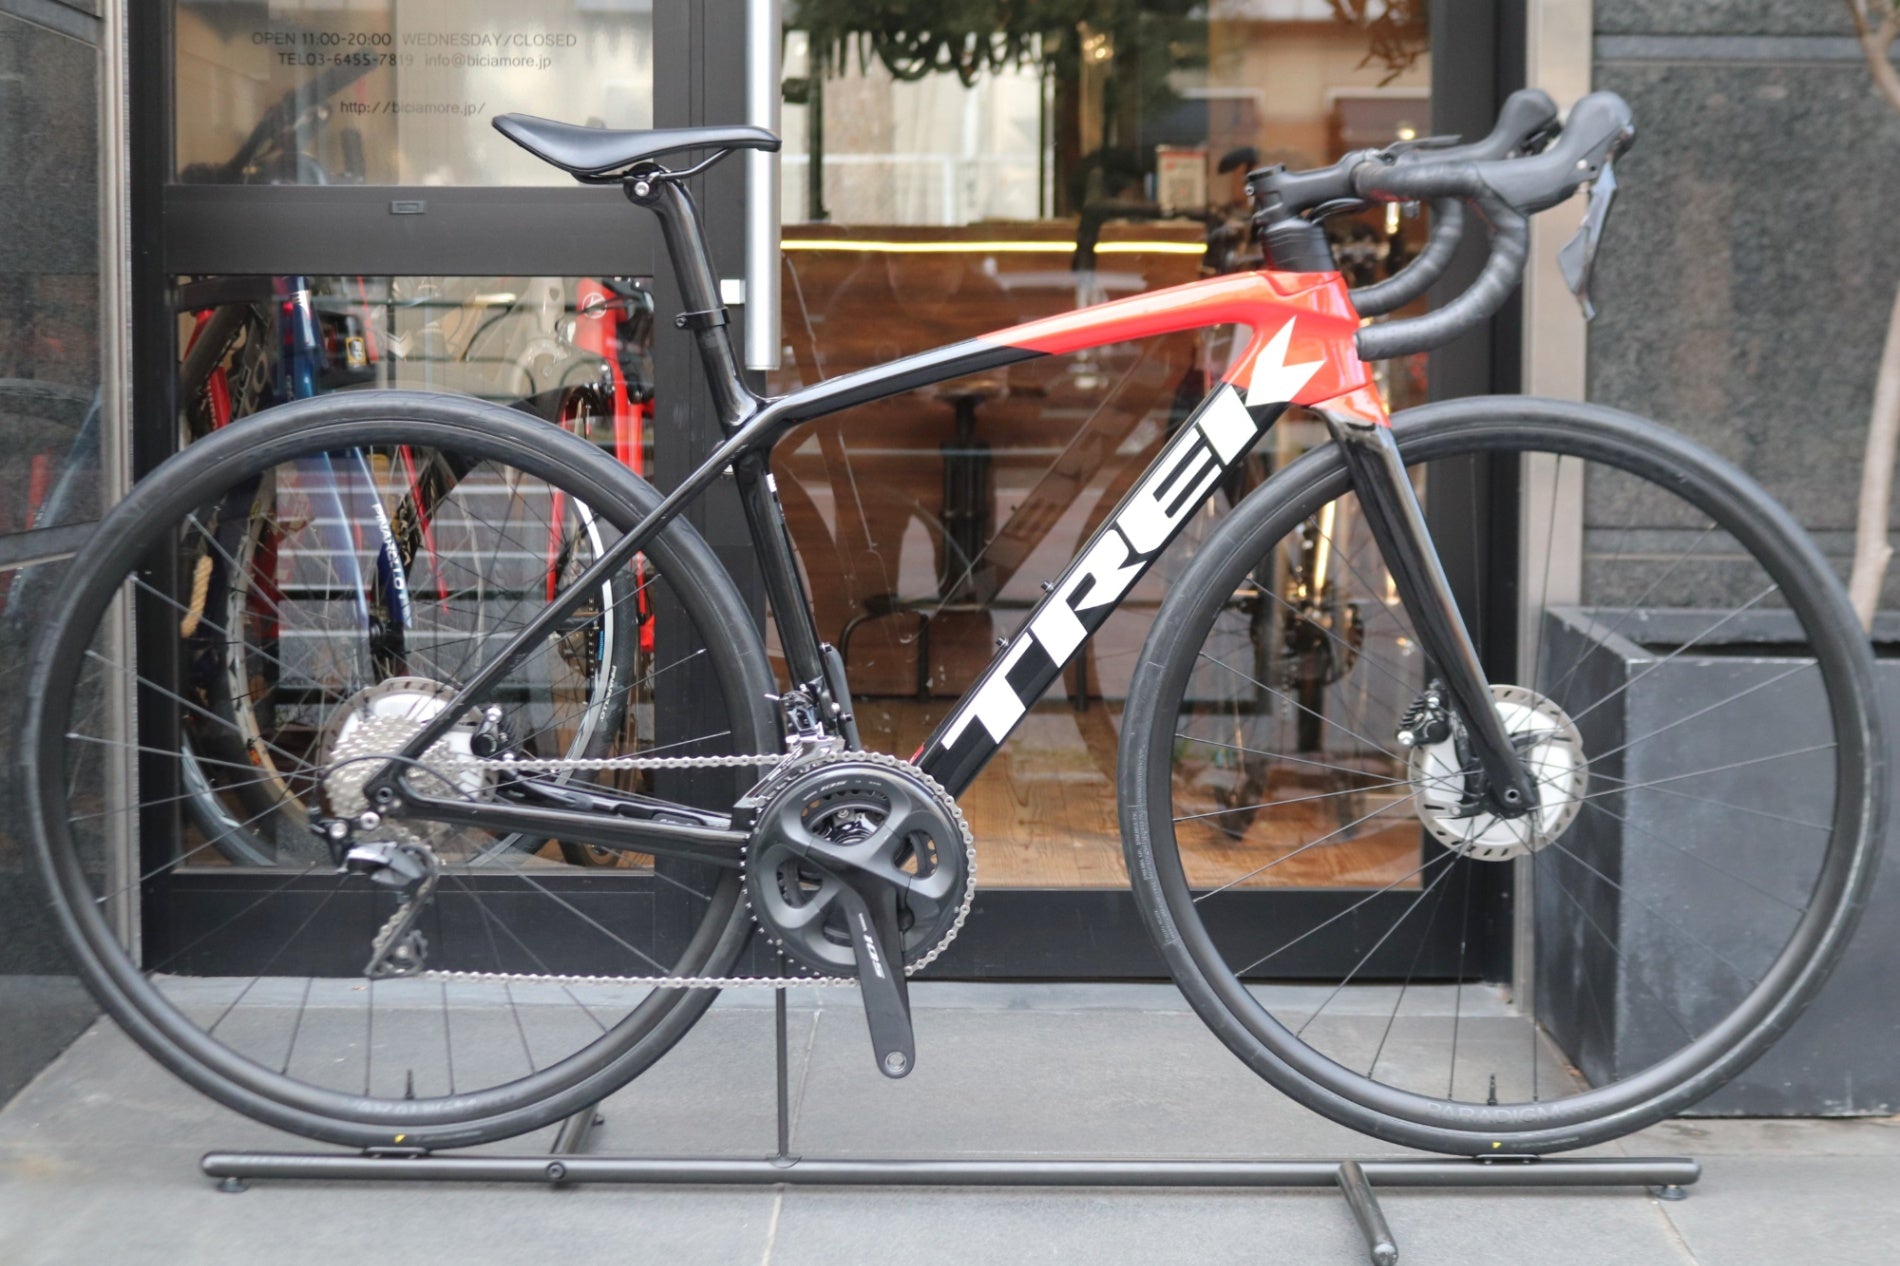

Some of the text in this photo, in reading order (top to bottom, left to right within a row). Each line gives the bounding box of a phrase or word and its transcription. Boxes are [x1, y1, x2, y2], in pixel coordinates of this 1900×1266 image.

[252, 32, 577, 47] OPEN 11:00-20:00 WEDNESDAY/CLOSED
[425, 54, 552, 70] info@biciamore.jp
[340, 101, 486, 116] http://biciamore.jp/
[941, 314, 1326, 751] TREK
[863, 934, 886, 980] 105
[1427, 1100, 1562, 1125] PARADIGM
